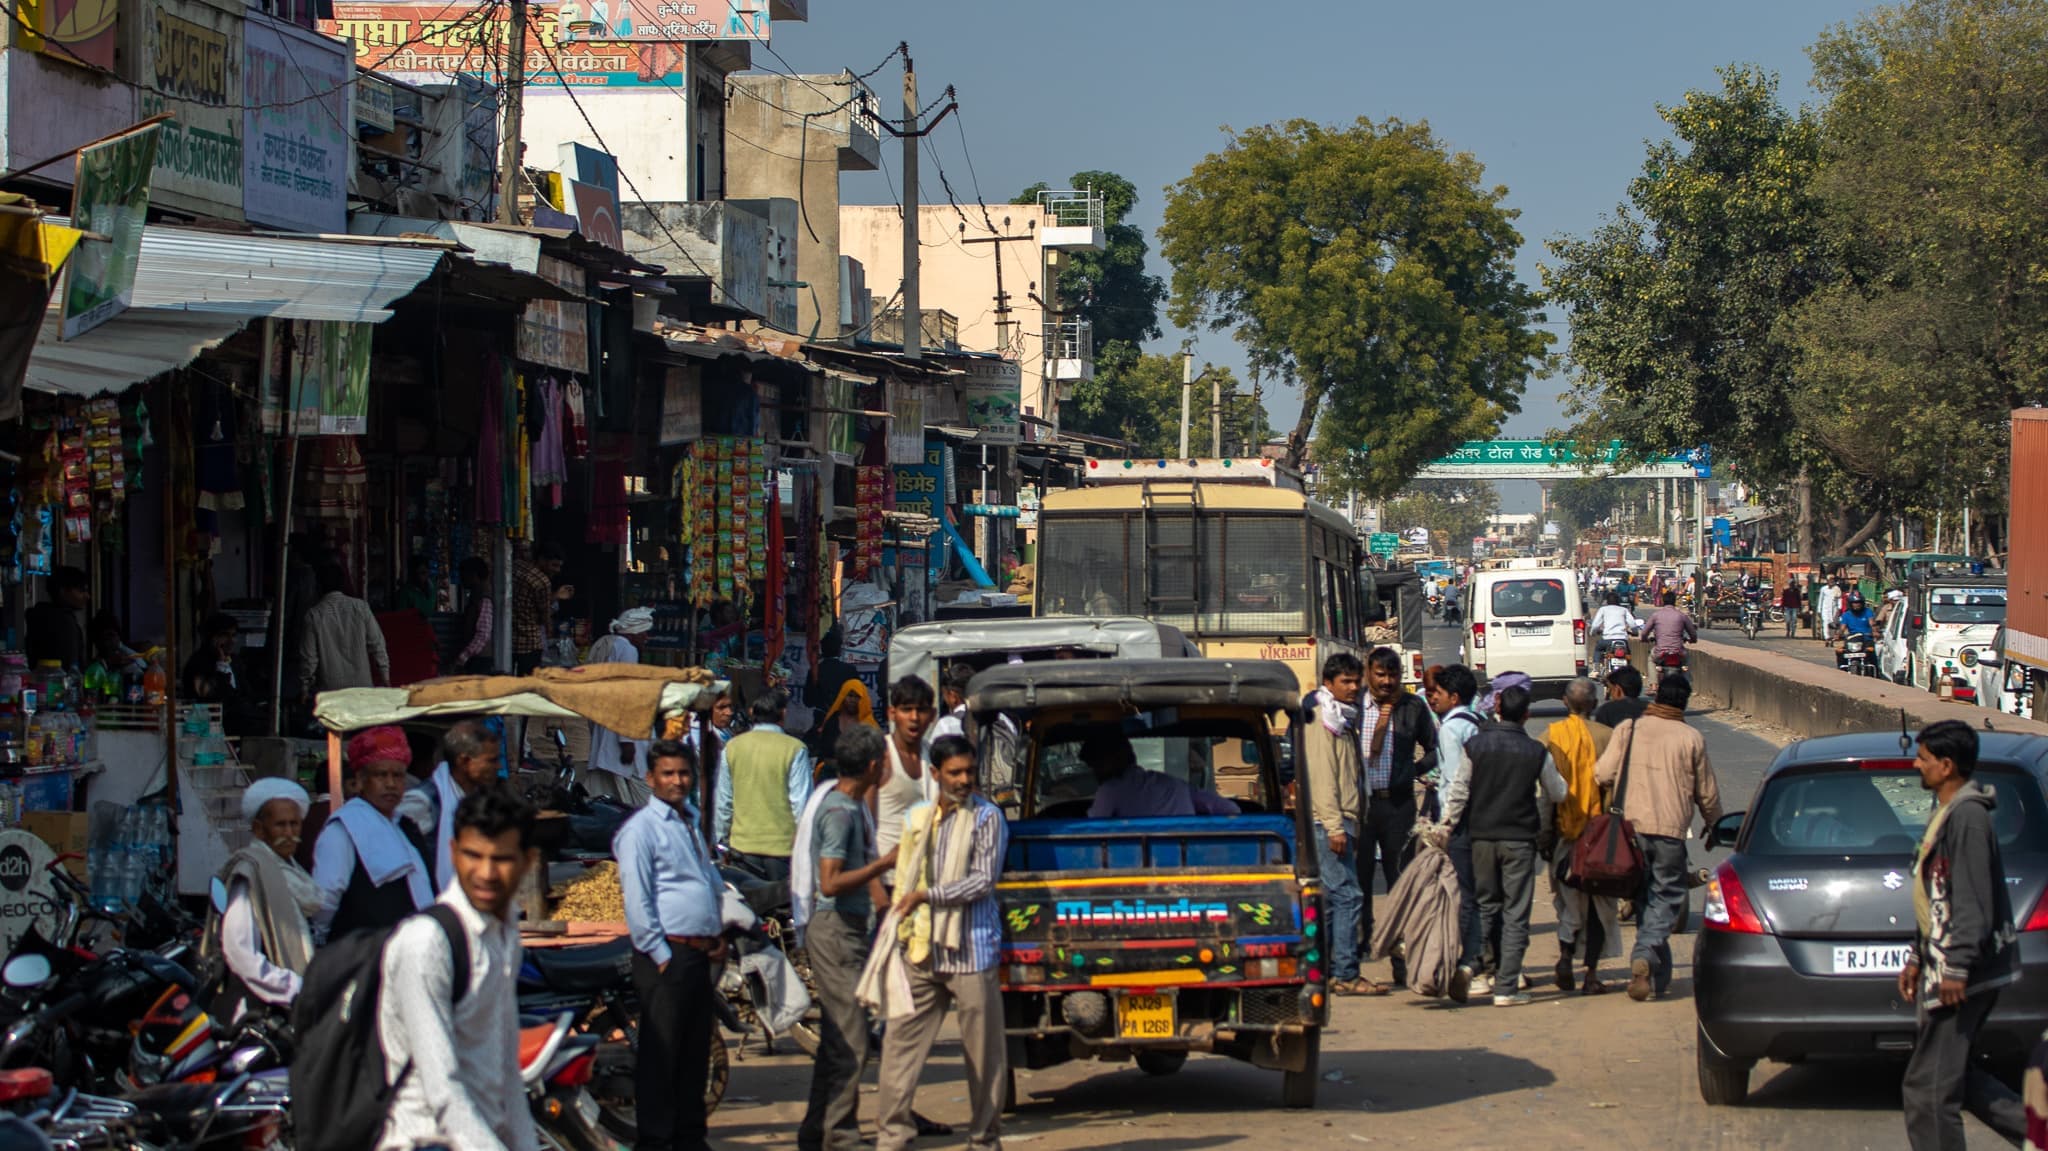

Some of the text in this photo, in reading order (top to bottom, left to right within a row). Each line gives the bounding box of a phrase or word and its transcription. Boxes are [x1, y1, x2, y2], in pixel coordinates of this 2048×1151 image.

[335, 19, 412, 57] गुप्ता
[552, 48, 628, 71] विक्रेता
[1487, 445, 1514, 459] टोल
[1519, 445, 1543, 459] रोड
[1260, 641, 1312, 659] VIKRANT
[1056, 897, 1228, 925] Mahindra
